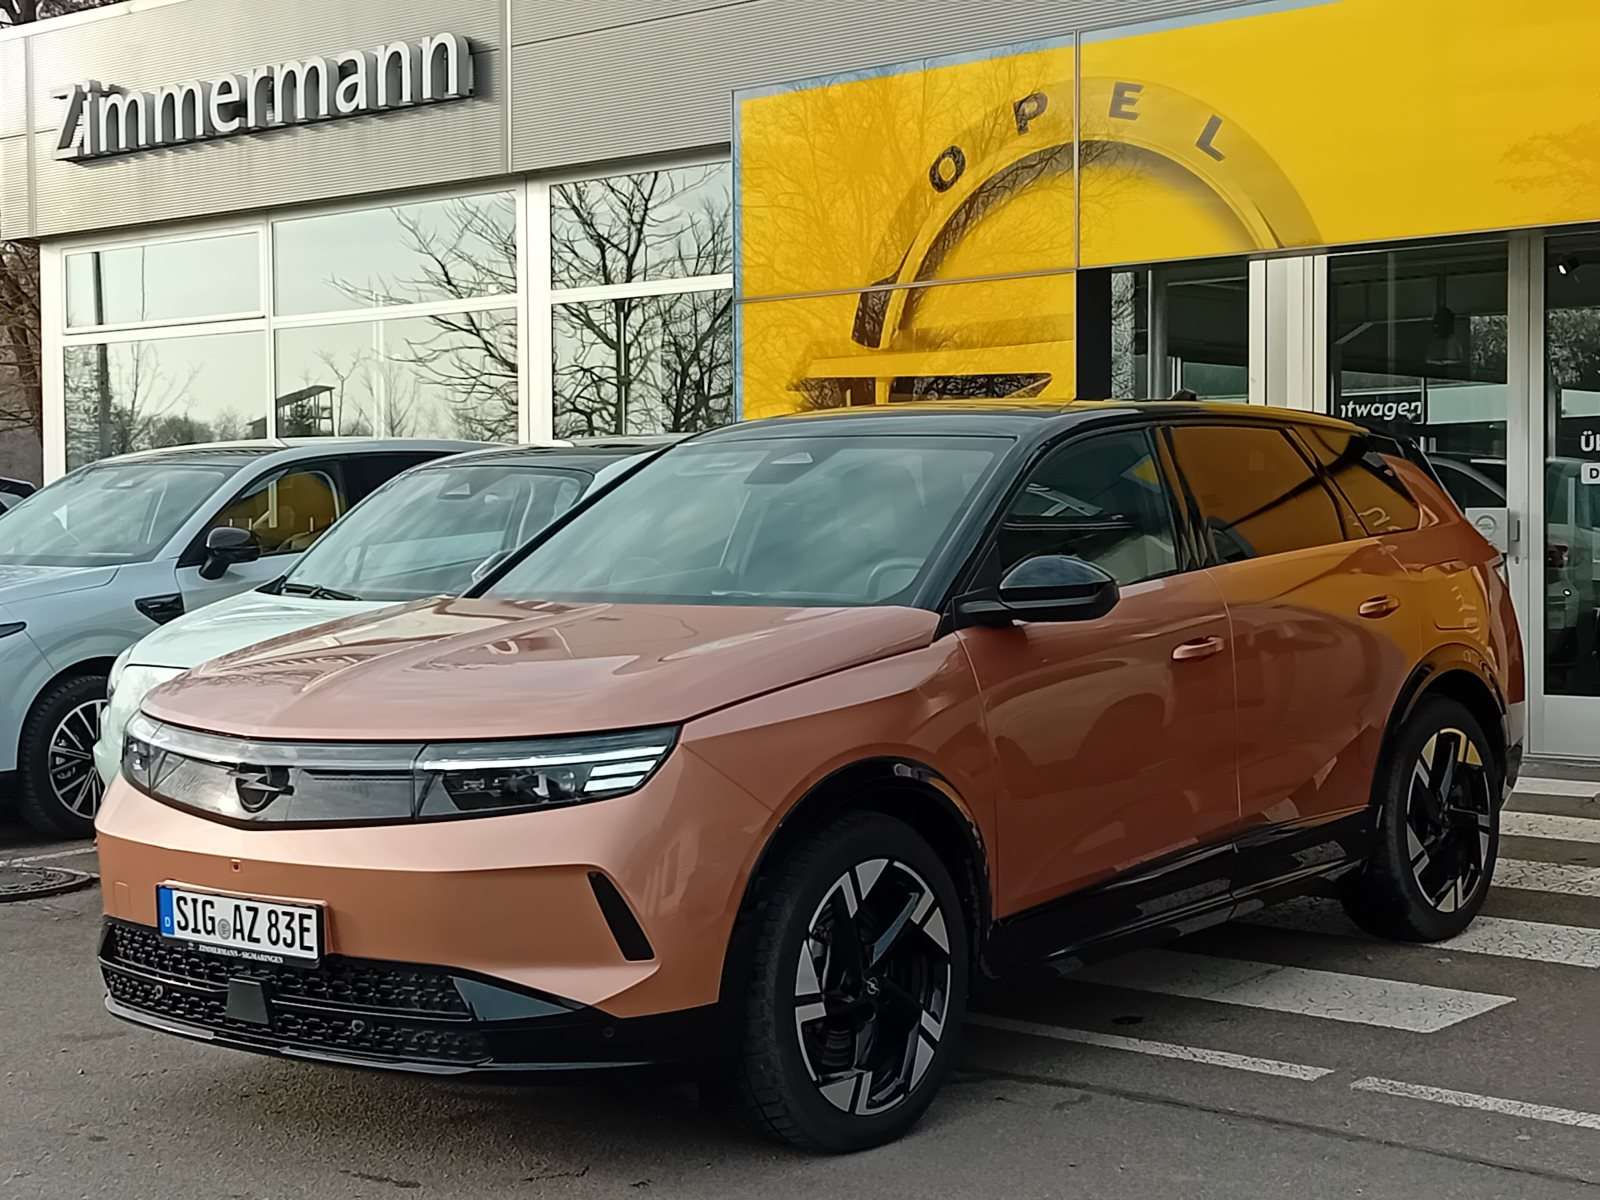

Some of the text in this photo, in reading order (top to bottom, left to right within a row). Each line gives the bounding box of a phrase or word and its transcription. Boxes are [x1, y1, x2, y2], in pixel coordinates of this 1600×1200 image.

[53, 32, 474, 161] Zimmermann
[929, 81, 1226, 193] OPEL
[175, 895, 314, 952] SIG AZ 83E
